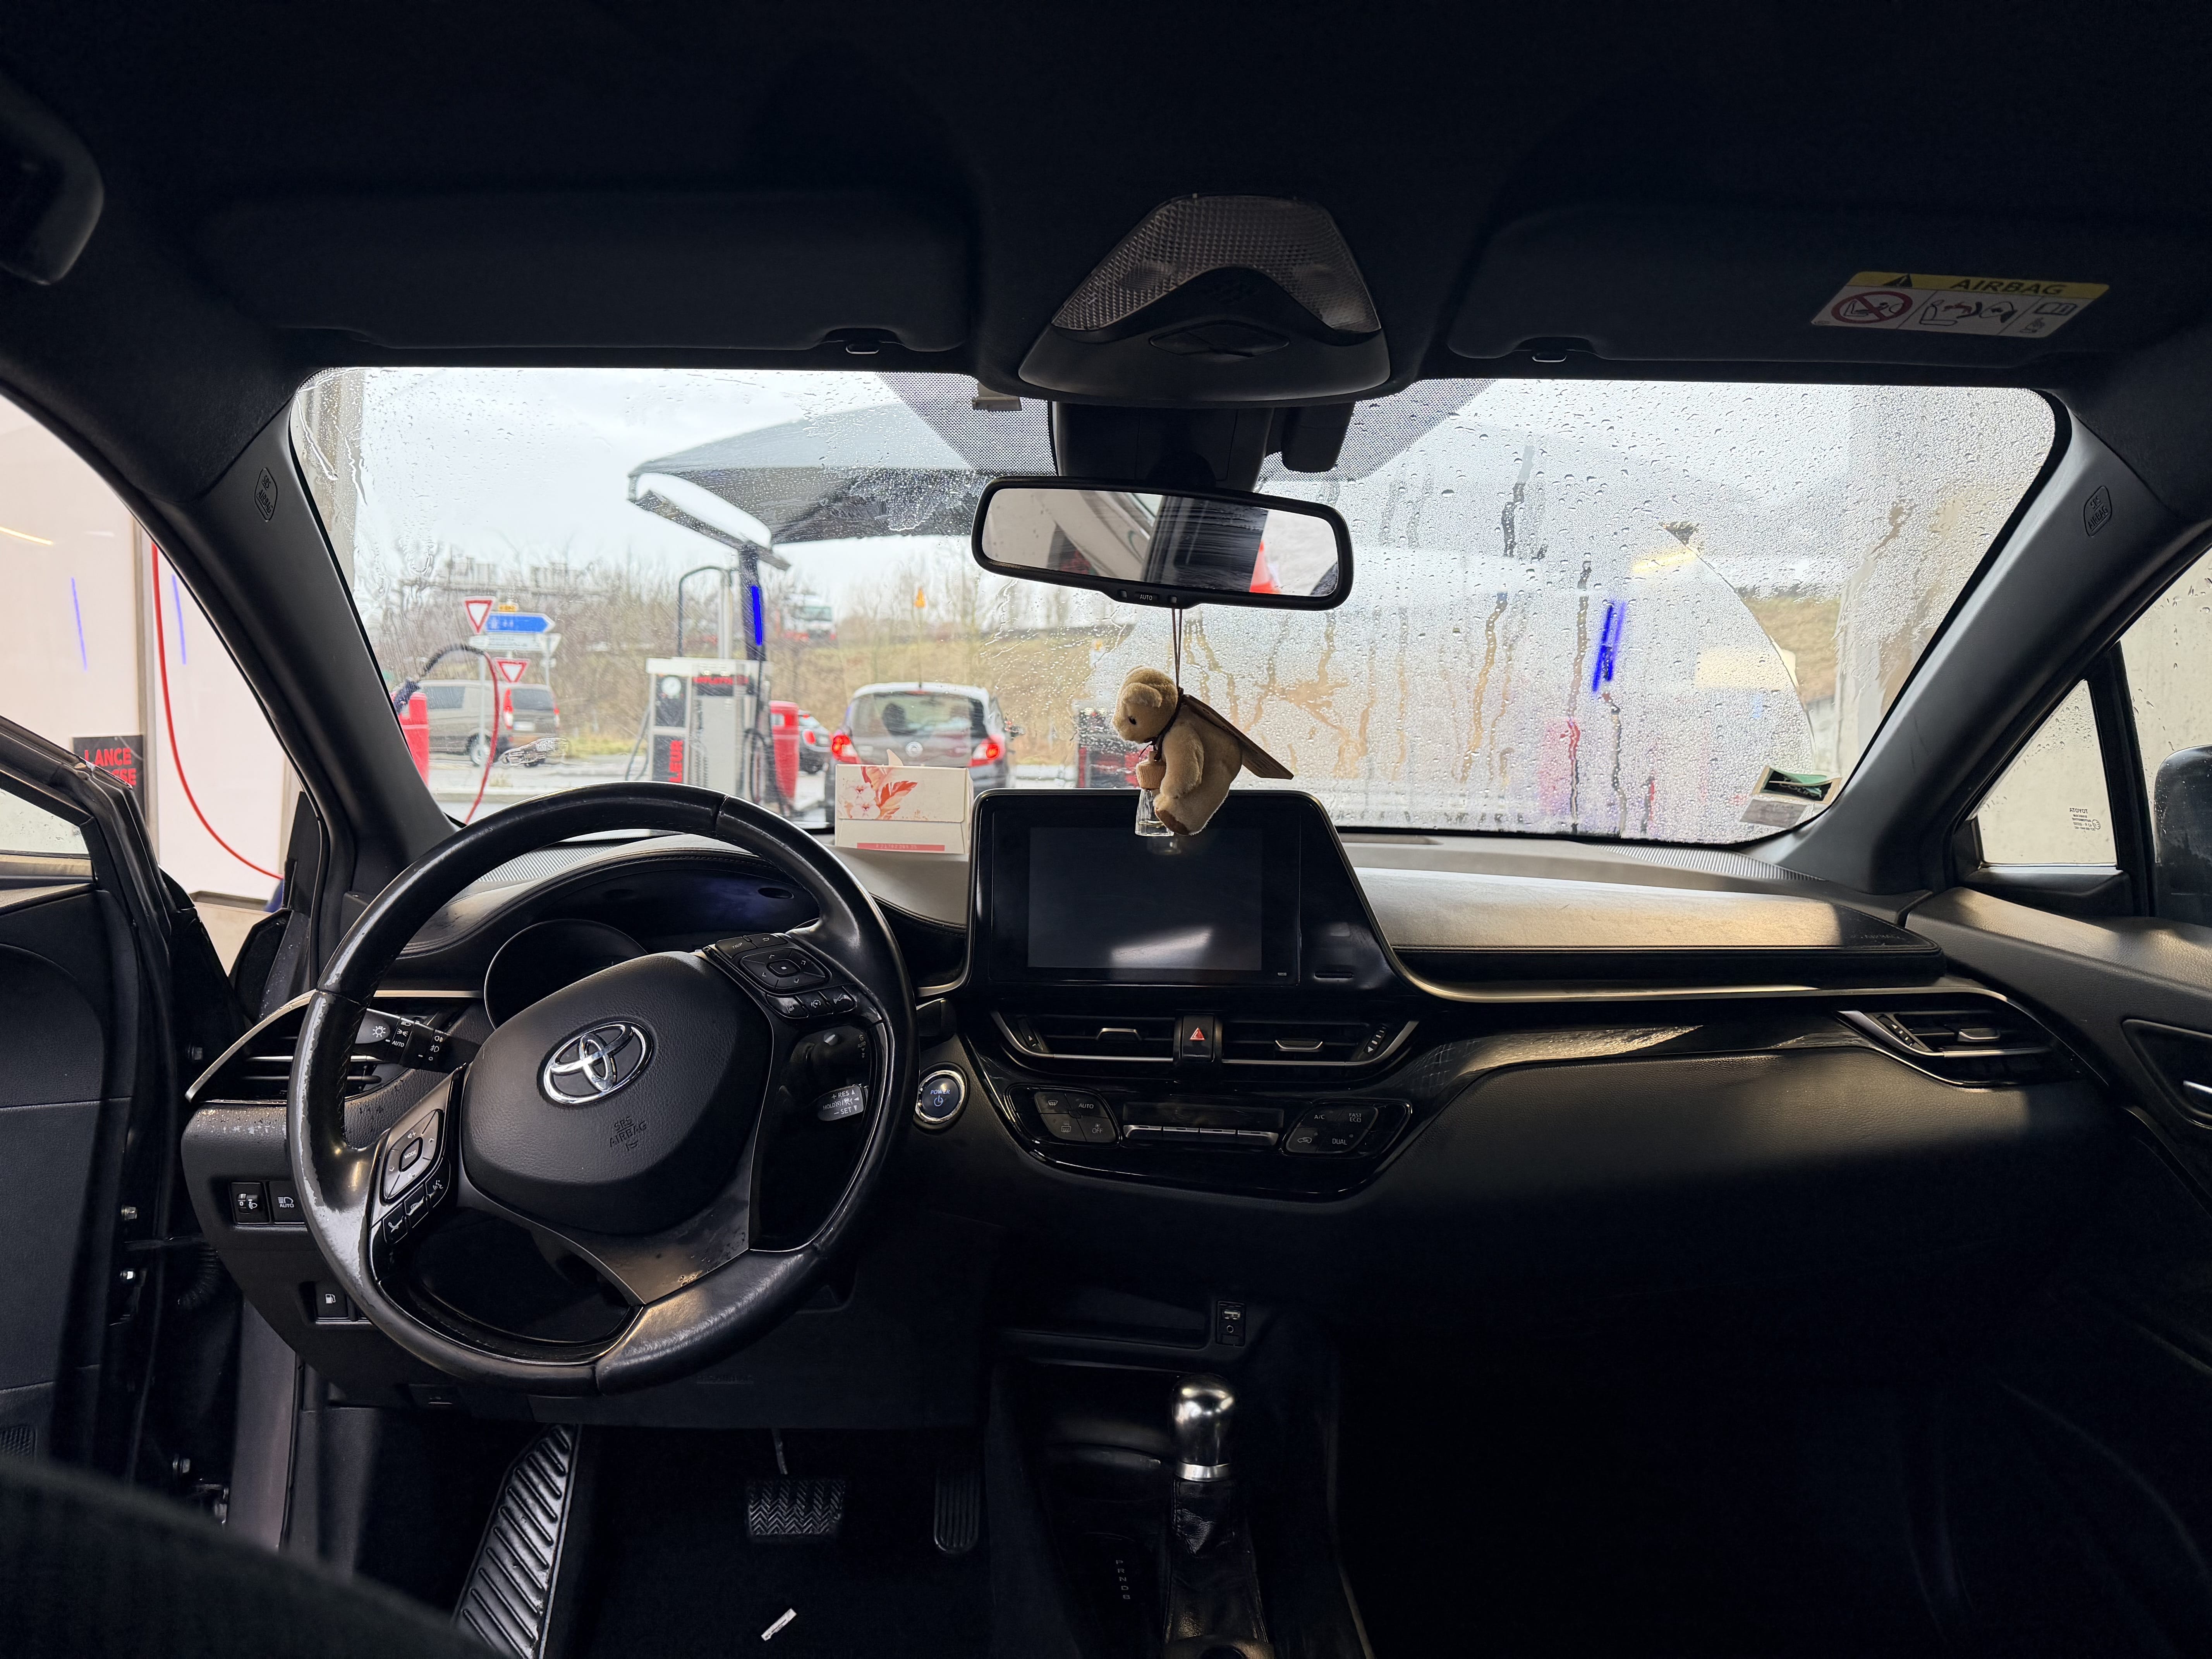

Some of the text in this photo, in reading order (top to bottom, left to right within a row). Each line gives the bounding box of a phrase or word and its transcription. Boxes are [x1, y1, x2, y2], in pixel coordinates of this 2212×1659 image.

[1949, 279, 2067, 295] AIRBAG
[262, 475, 271, 488] SRS
[257, 489, 273, 513] AIRBAG
[2090, 496, 2101, 509] SRS
[2088, 506, 2108, 530] AIRBAG
[84, 747, 132, 766] LANCE
[614, 1116, 633, 1131] SRS
[610, 1120, 647, 1147] AIRBAG
[404, 1150, 417, 1159] MODE
